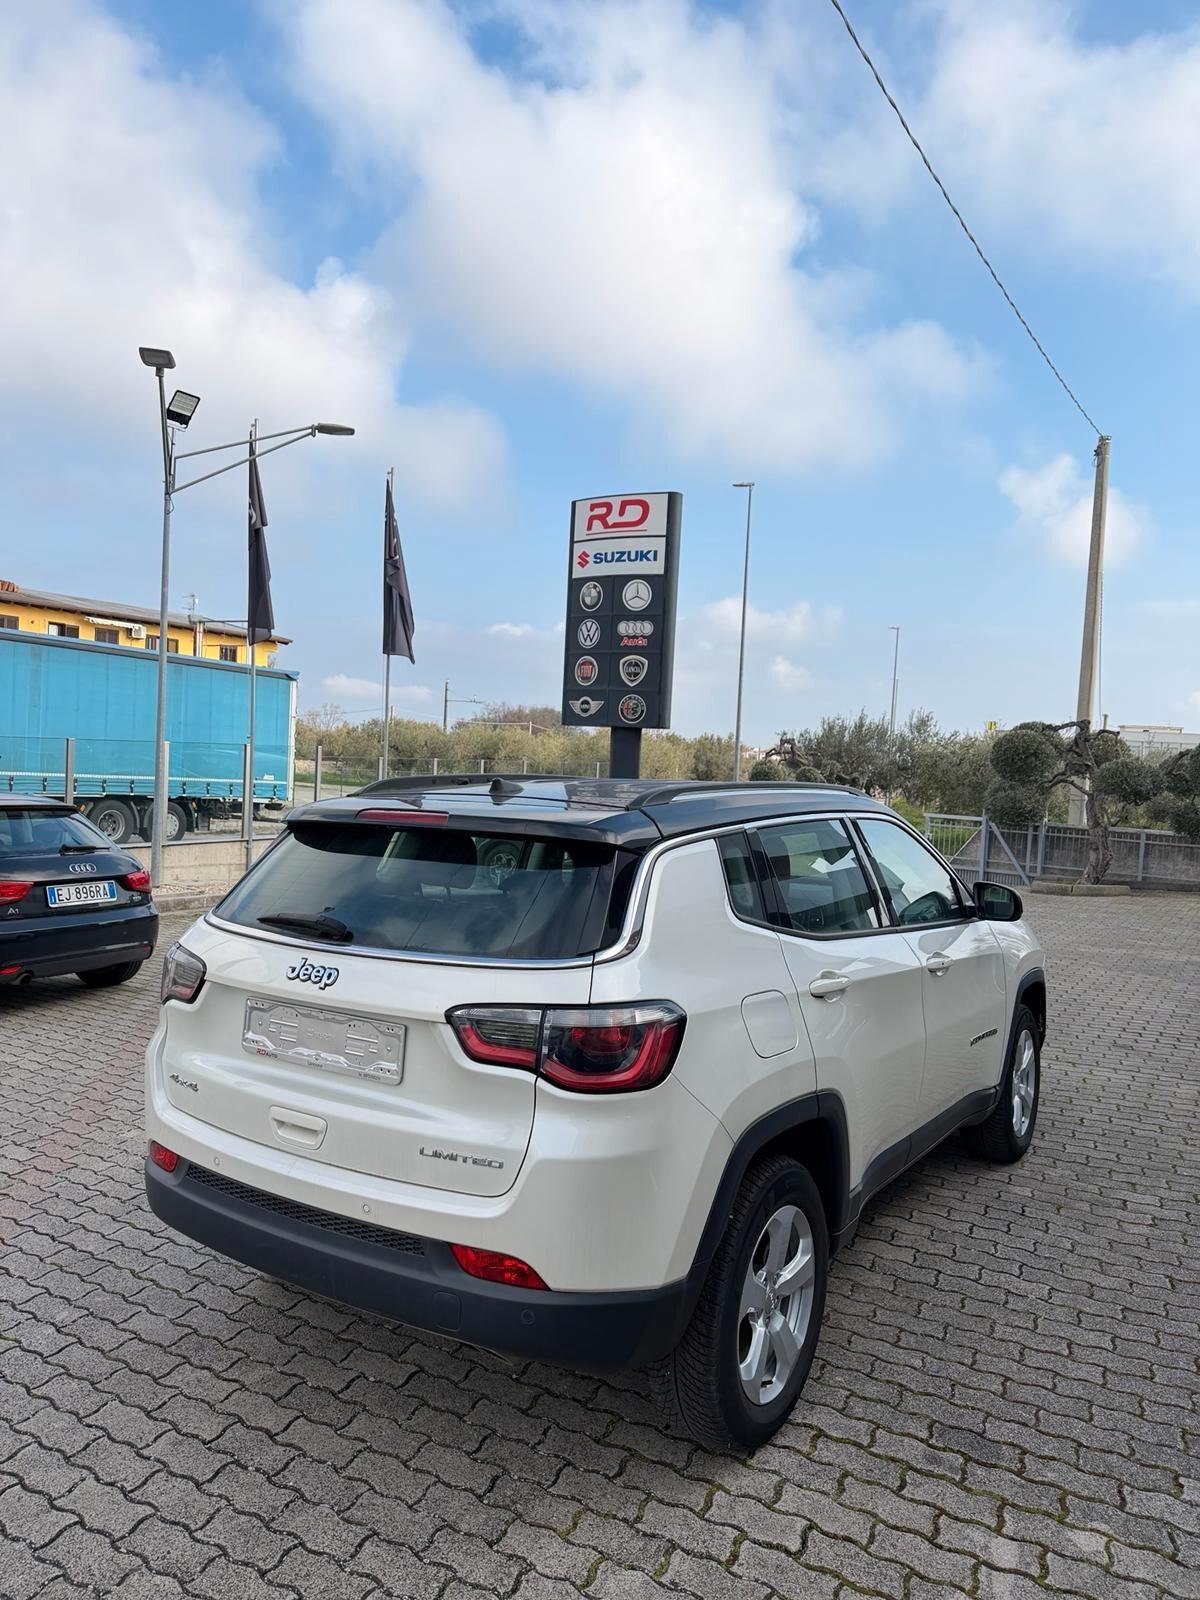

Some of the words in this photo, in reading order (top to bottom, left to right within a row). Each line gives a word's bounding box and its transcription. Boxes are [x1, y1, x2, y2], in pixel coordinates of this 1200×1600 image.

[586, 498, 650, 532] RD
[593, 549, 658, 565] SUZUKI
[620, 636, 648, 647] Audi
[57, 888, 71, 902] EJ
[76, 885, 109, 900] 896RA
[7, 907, 19, 915] A1
[286, 957, 340, 990] Jeep
[419, 1146, 504, 1170] LIMITED
